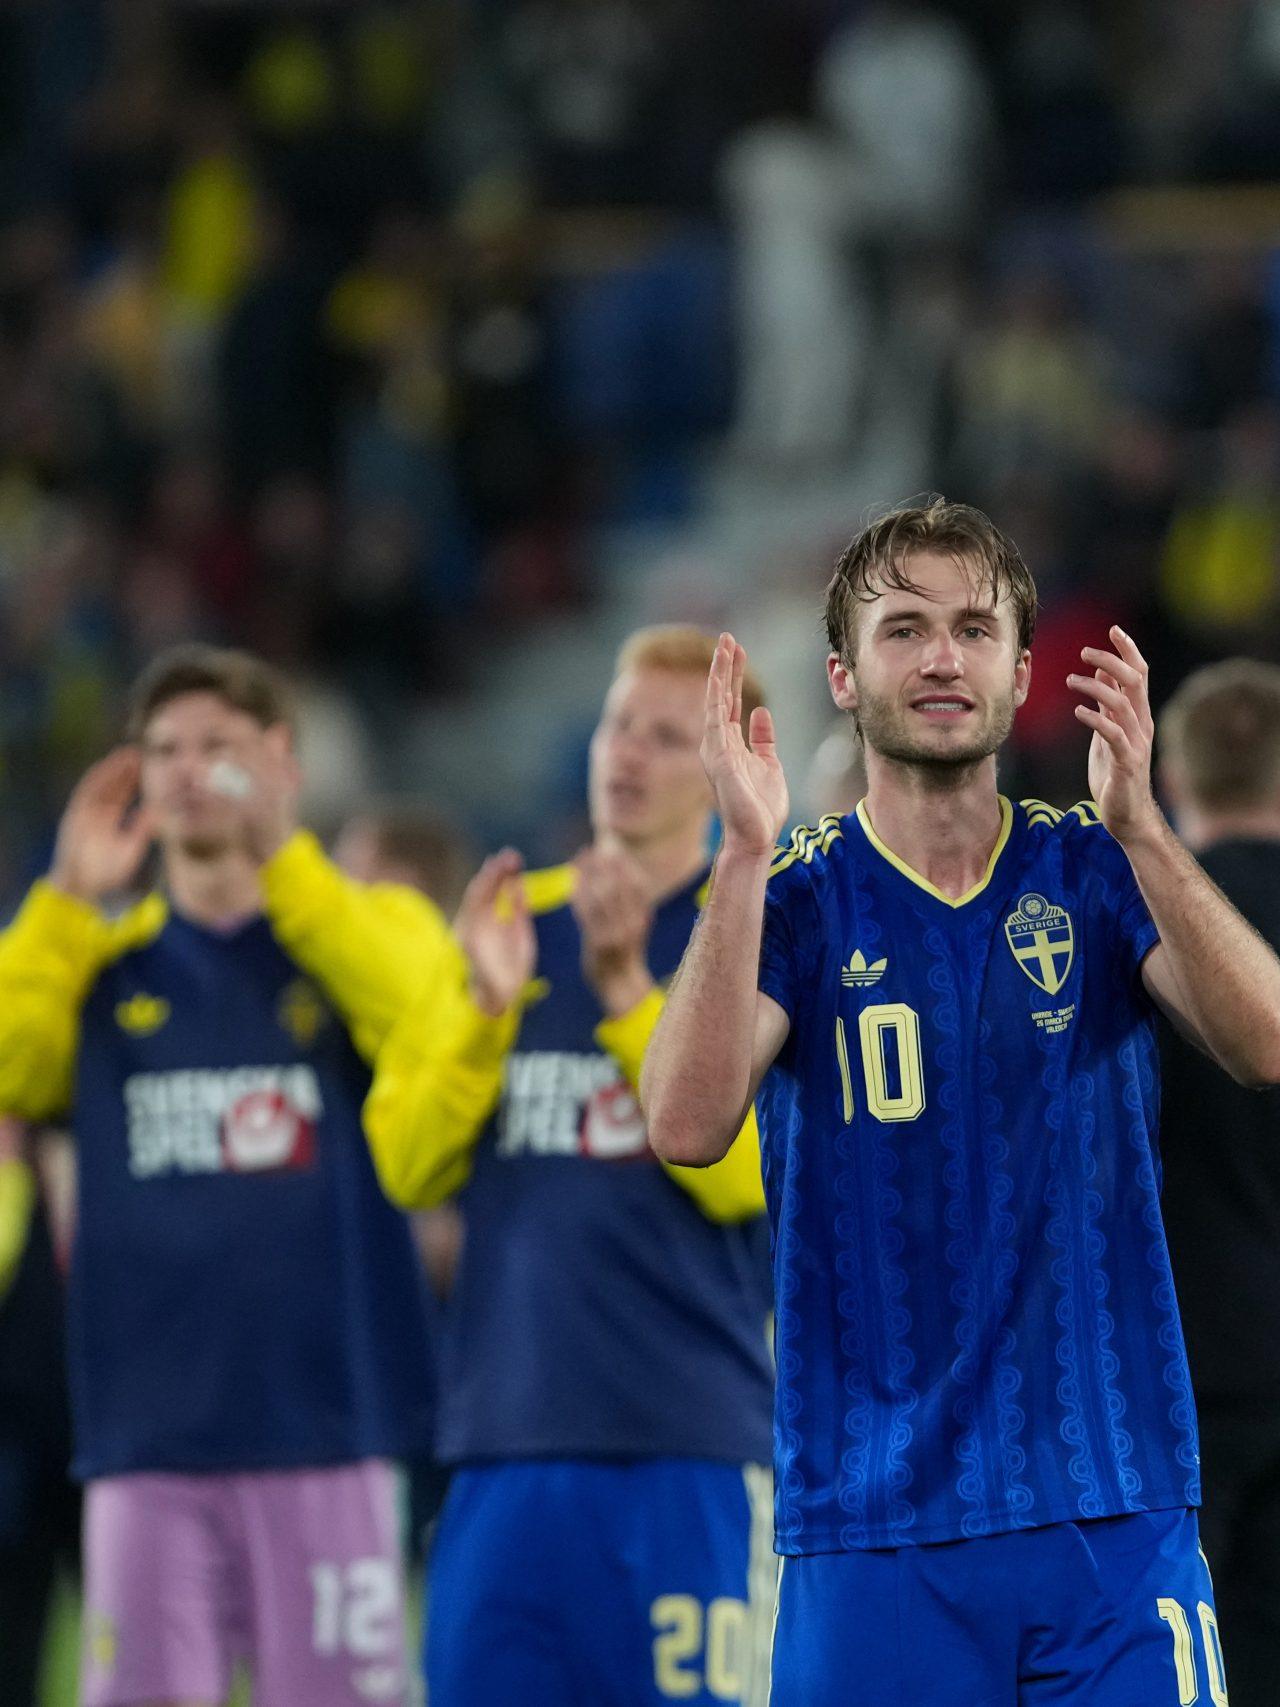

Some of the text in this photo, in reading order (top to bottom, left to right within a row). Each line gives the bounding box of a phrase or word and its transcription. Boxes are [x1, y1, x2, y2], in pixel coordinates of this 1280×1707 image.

[1015, 918, 1061, 933] SVERIGE
[312, 1560, 400, 1656] 12
[649, 1593, 750, 1700] 20
[1156, 1597, 1229, 1707] 10
